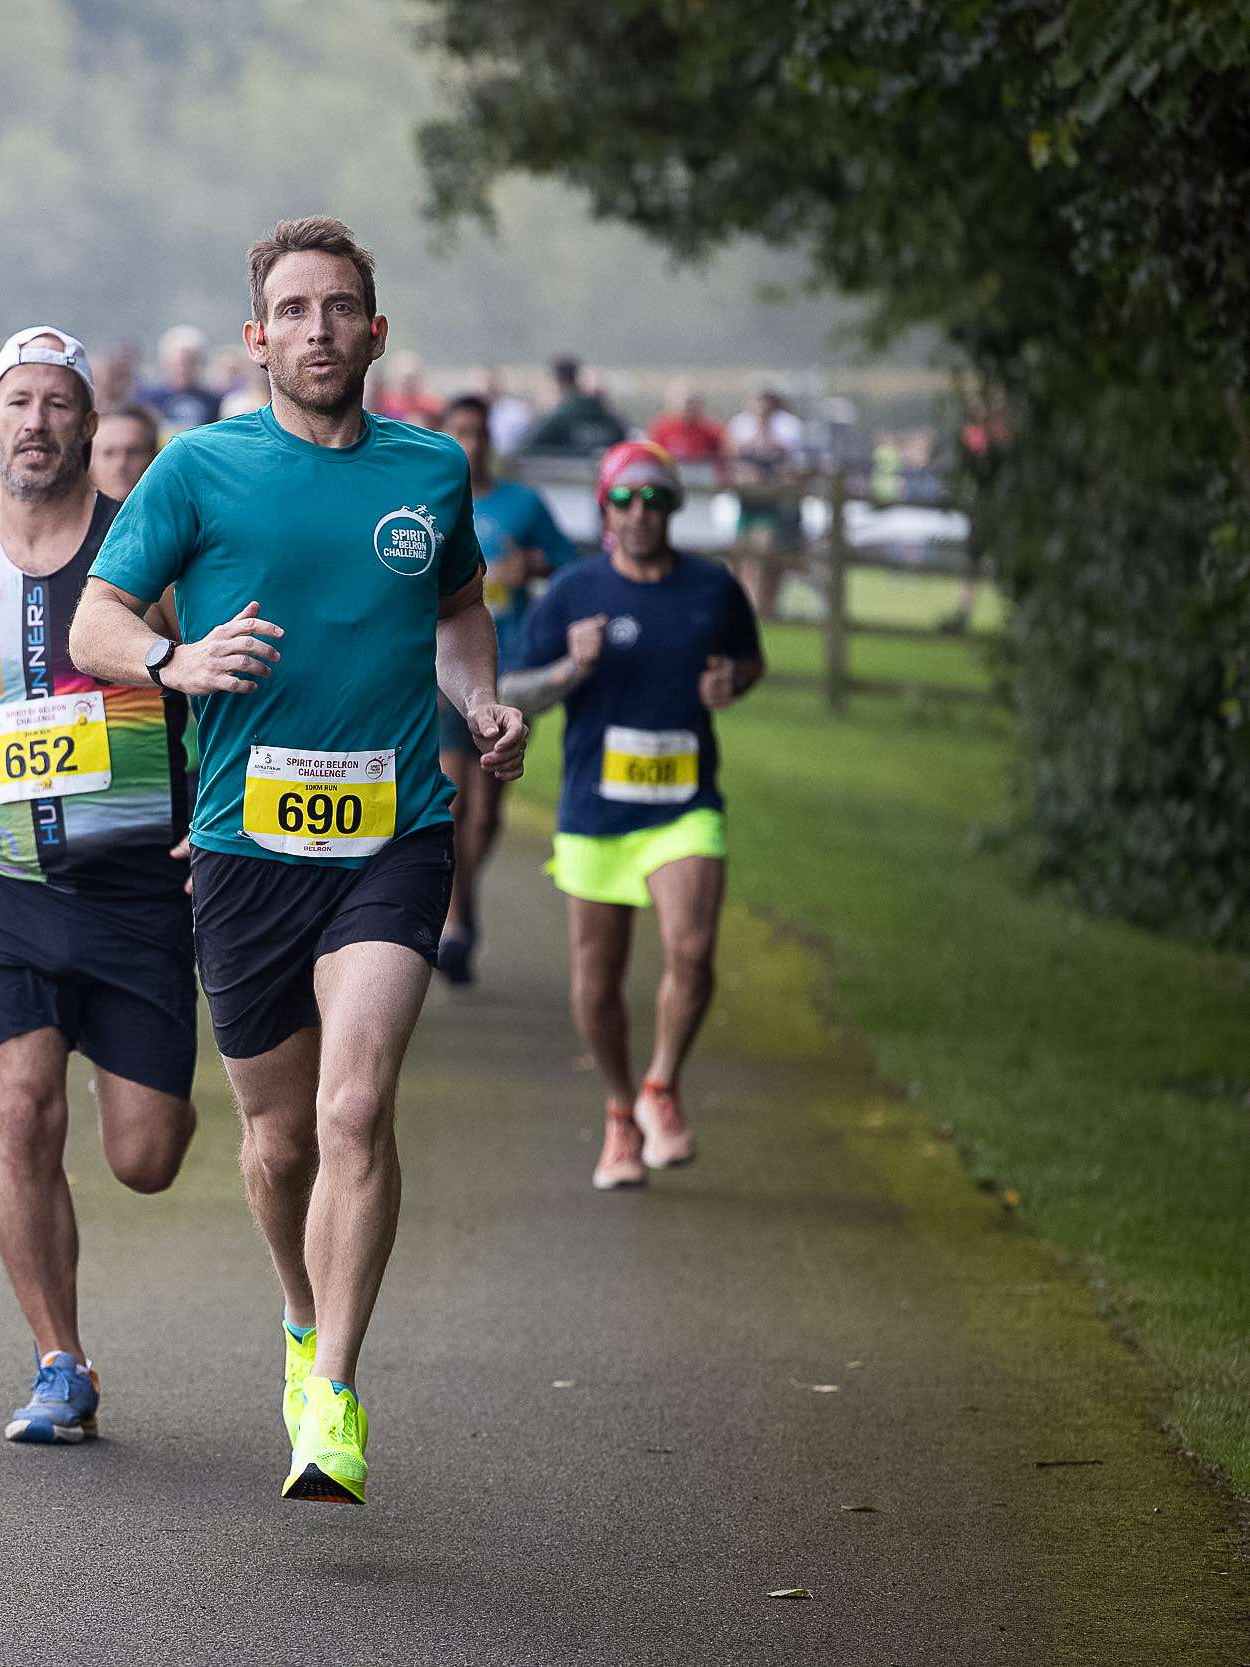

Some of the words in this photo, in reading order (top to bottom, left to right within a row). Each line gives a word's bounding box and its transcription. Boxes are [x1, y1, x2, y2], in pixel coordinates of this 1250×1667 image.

[391, 529, 426, 542] SPIRIT
[399, 541, 426, 551] BELRON
[383, 548, 426, 559] CHALLENGE
[39, 705, 67, 715] BELRON
[16, 714, 56, 726] CHALLENGE
[5, 736, 78, 779] 652
[286, 757, 313, 768] SPIRIT
[314, 760, 325, 768] OF
[327, 761, 359, 769] BELRON
[298, 768, 347, 778] CHALLENGE
[278, 792, 362, 835] 690
